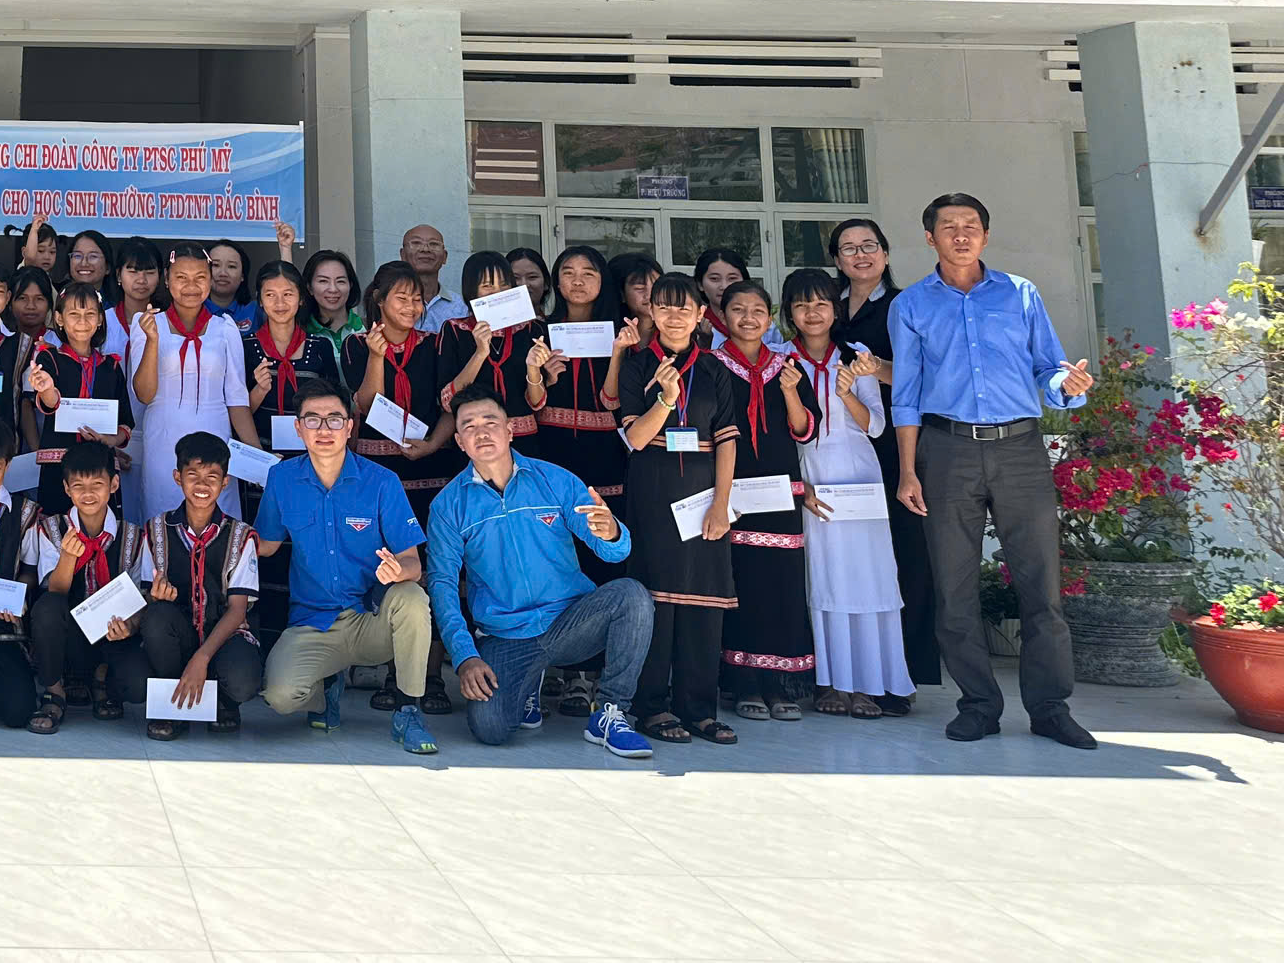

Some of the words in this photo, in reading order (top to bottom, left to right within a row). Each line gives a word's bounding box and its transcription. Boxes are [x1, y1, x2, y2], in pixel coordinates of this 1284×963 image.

[15, 143, 38, 169] CHI
[41, 138, 77, 170] ĐOÀN
[82, 139, 118, 171] CÔNG
[122, 146, 141, 171] TY
[143, 146, 177, 172] PTSC
[179, 141, 207, 173] PHÚ
[211, 141, 232, 174] MỸ
[3, 189, 29, 215] CHO
[66, 191, 97, 217] SINH
[101, 186, 156, 219] TRƯỜNG
[159, 194, 212, 219] PTDTNT
[214, 181, 242, 220] BẮC
[246, 188, 280, 222] BÌNH
